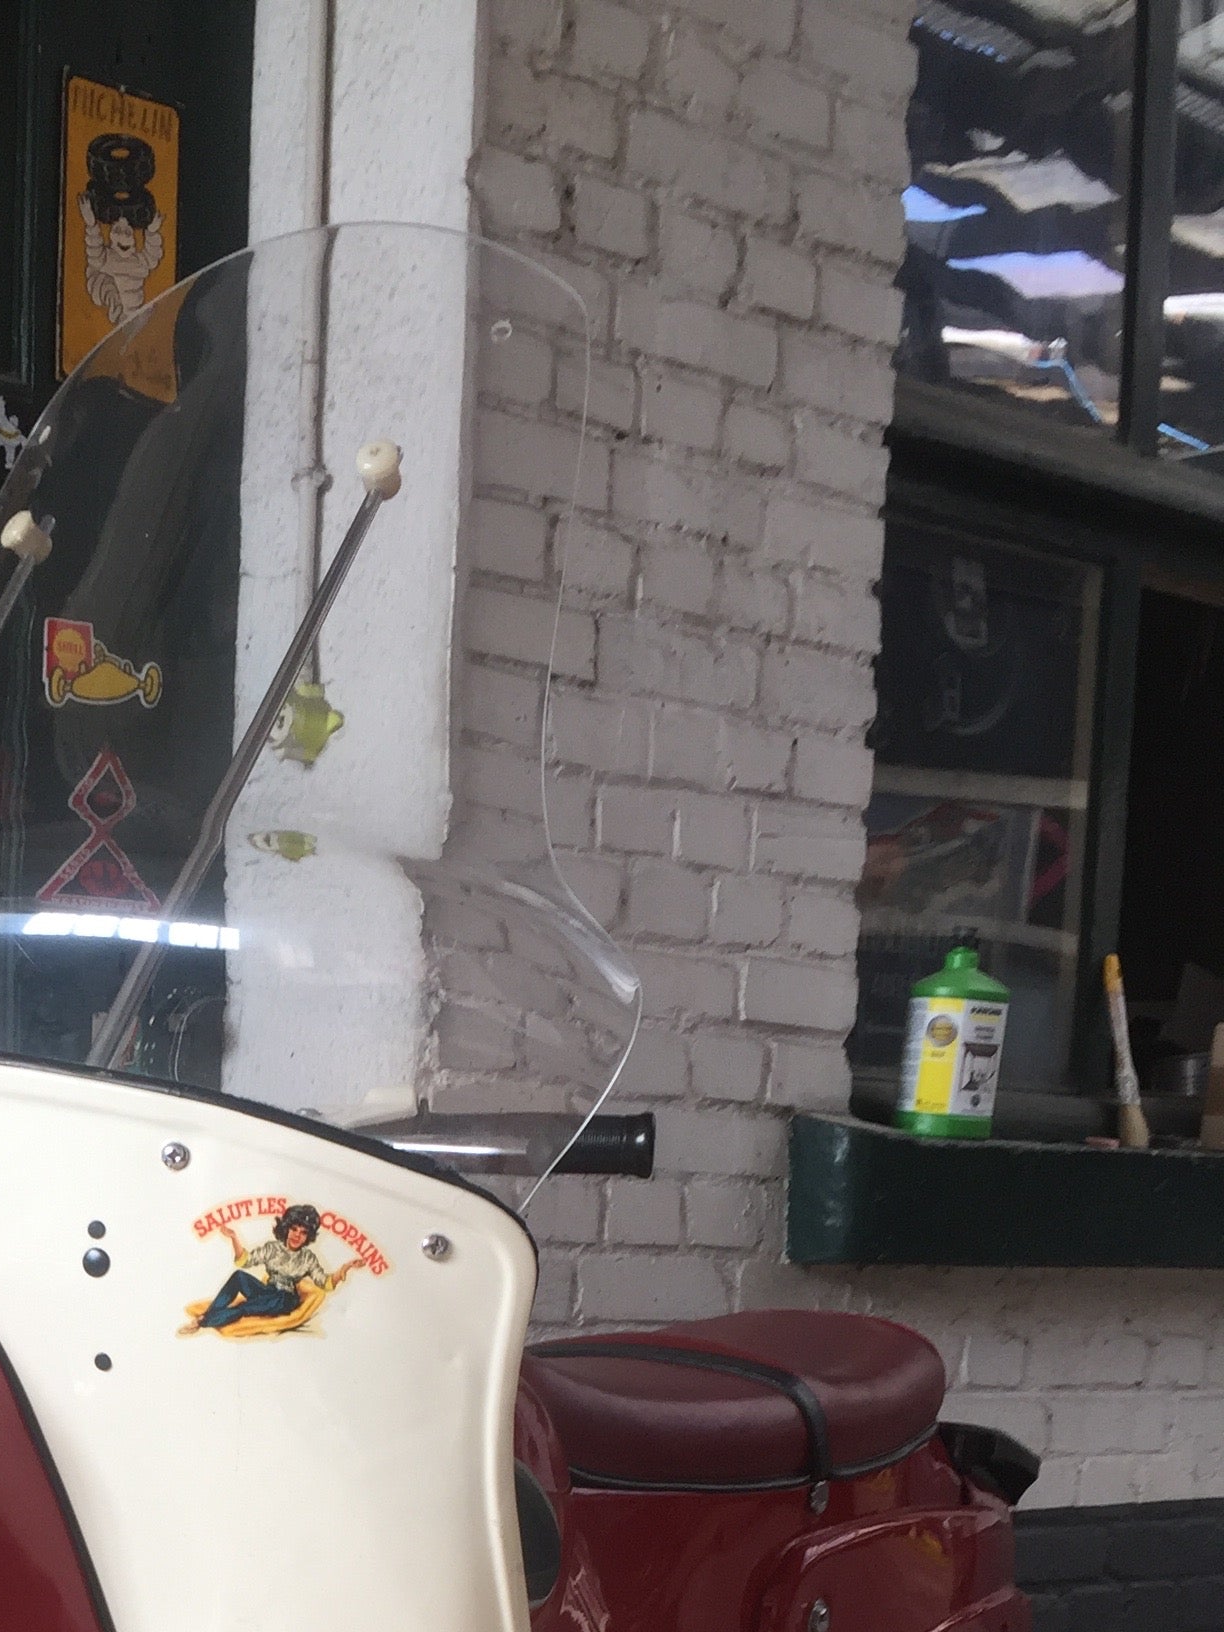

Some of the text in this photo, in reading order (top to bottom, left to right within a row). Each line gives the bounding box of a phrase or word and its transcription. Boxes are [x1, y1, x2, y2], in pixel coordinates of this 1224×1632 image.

[71, 84, 174, 143] MICHELIN
[193, 1197, 389, 1276] SALUT LES COPAINS
